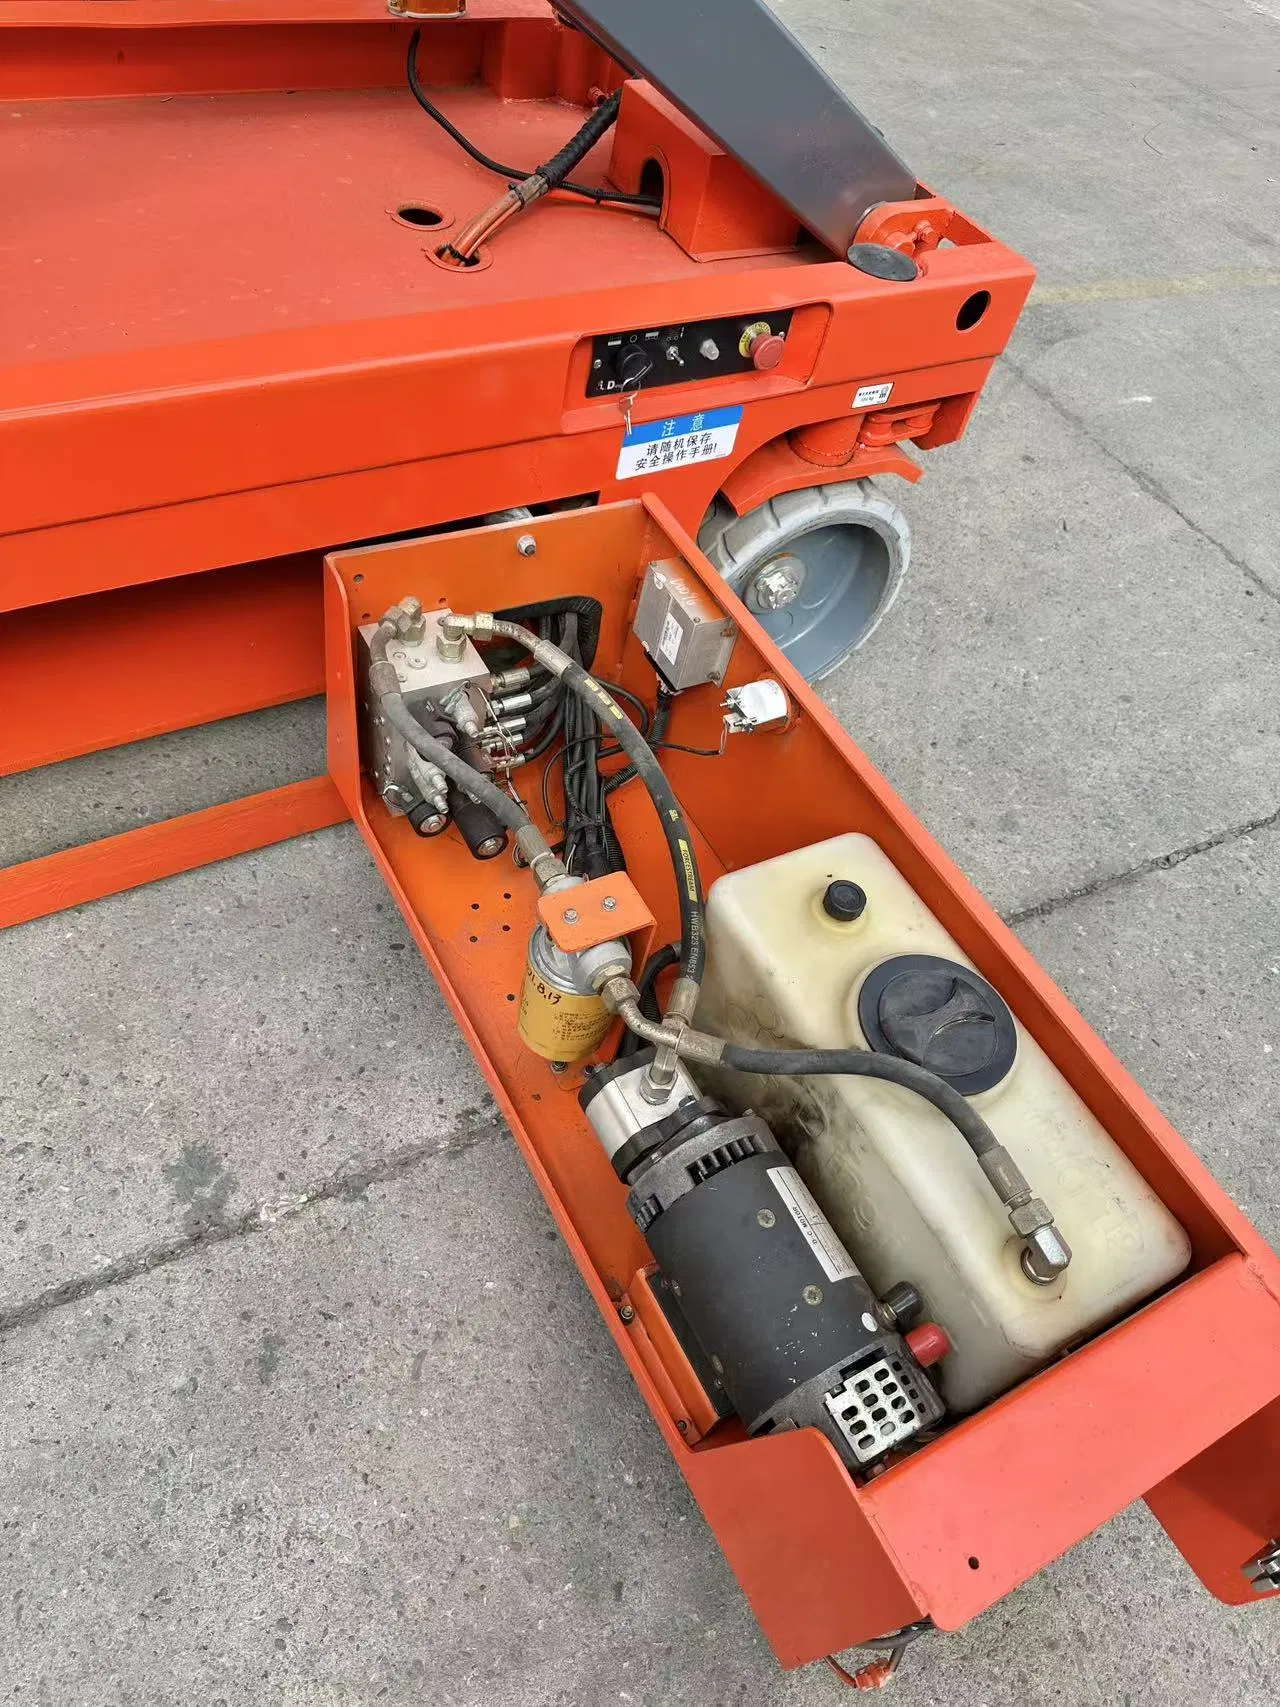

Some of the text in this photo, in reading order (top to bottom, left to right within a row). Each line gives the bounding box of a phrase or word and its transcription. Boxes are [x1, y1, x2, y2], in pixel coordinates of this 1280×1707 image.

[661, 413, 705, 437] 注意
[646, 432, 712, 456] 请随机保存
[635, 443, 718, 471] 安全操作手册!
[682, 849, 695, 892] FORCESTREAM
[687, 947, 699, 974] EN853
[792, 1206, 808, 1228] MOTOR
